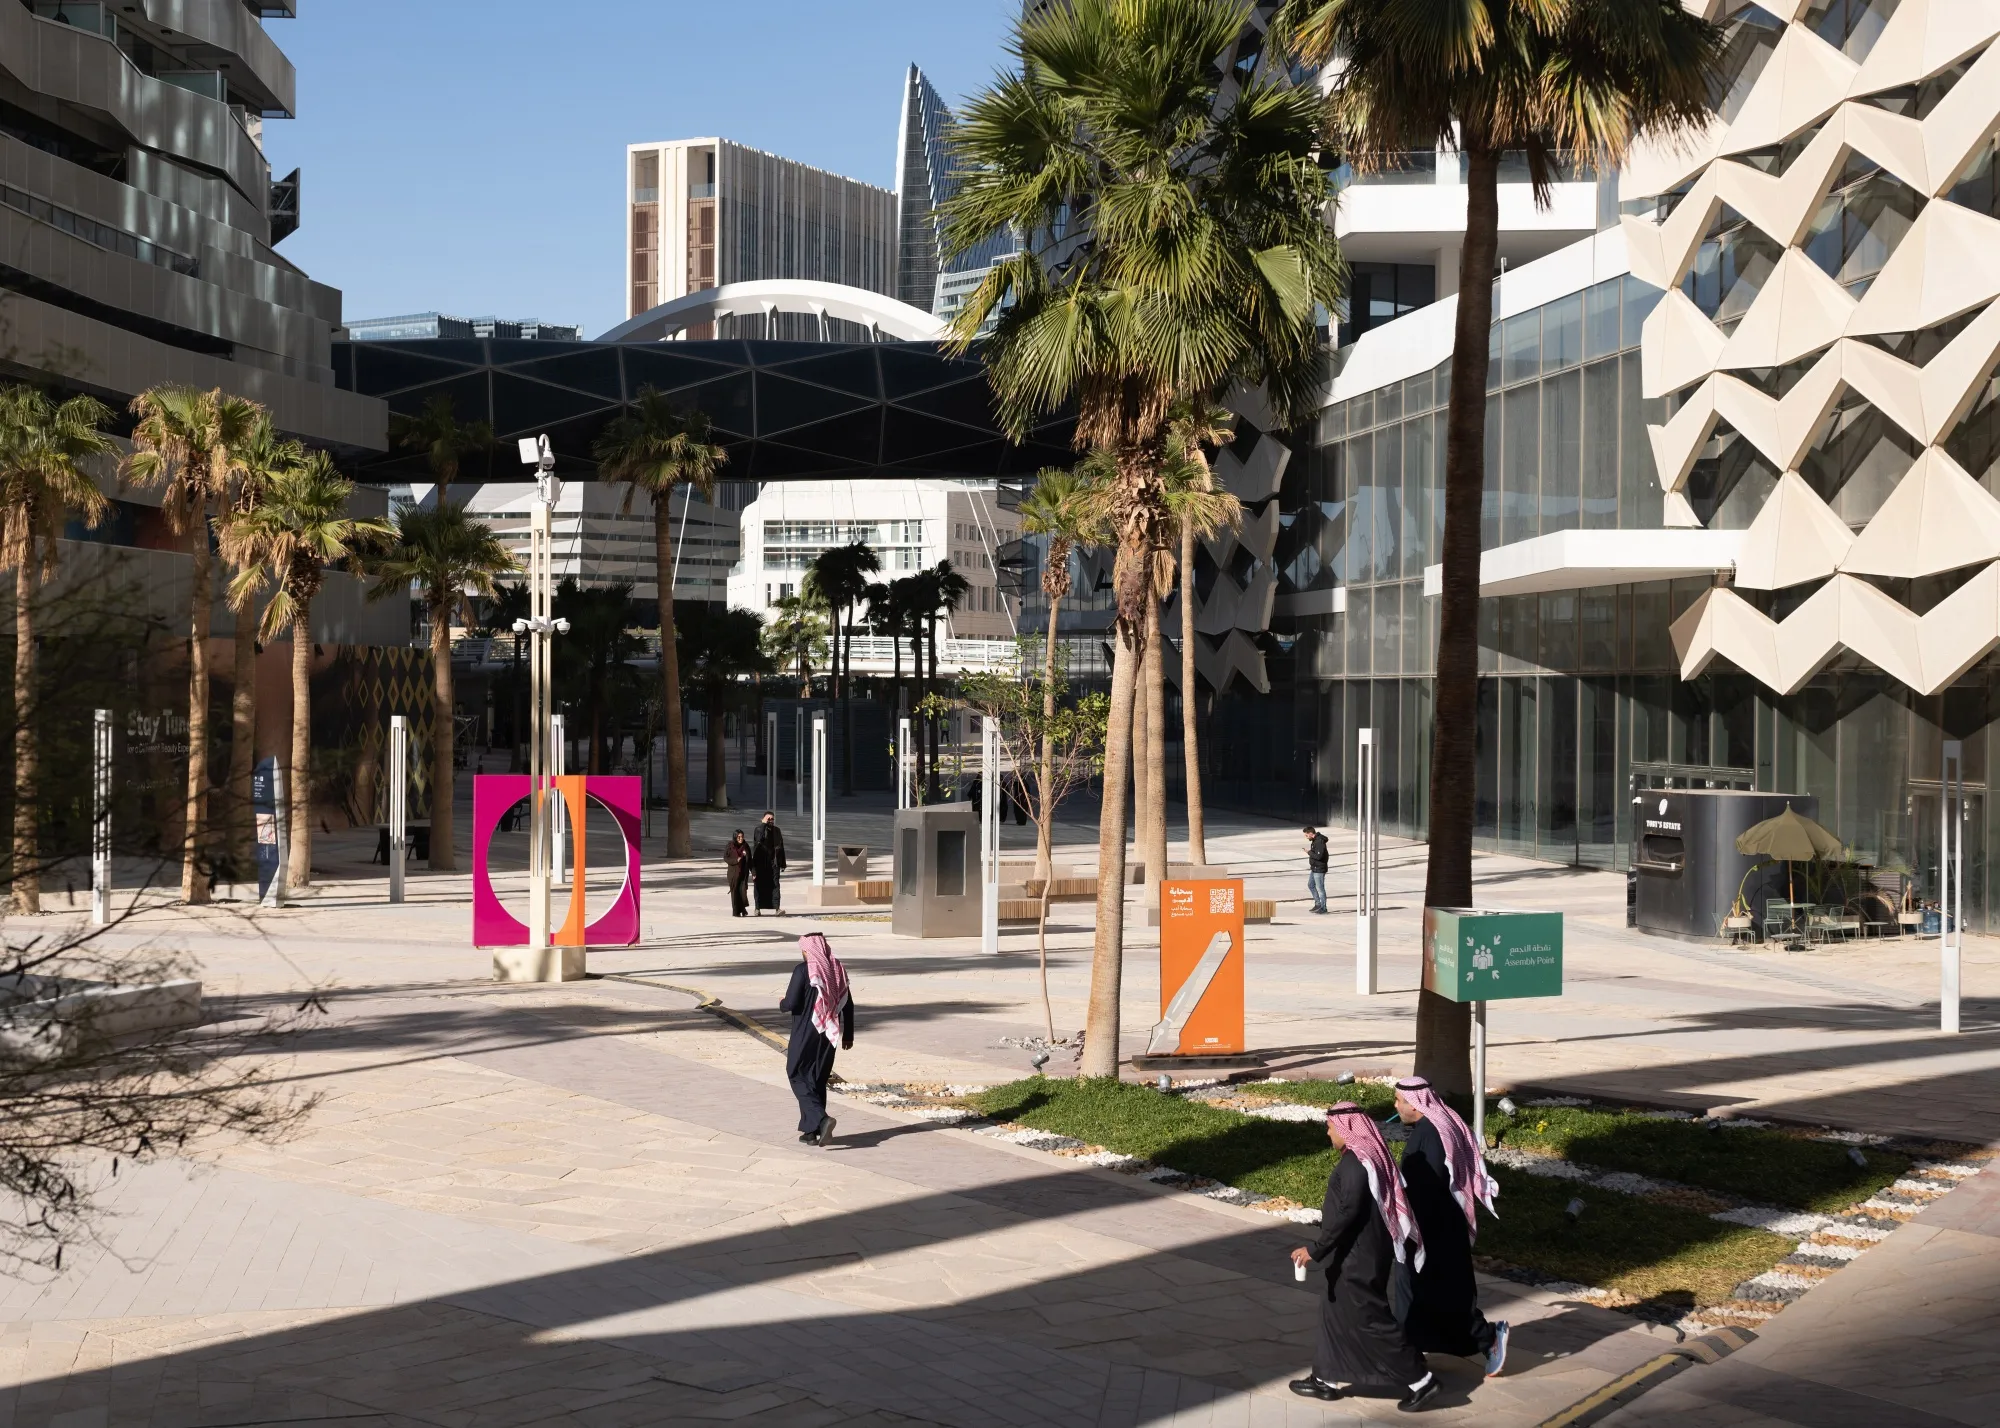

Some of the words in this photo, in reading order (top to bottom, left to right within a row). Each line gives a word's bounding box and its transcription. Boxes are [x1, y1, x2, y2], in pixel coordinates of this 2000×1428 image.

[127, 709, 161, 743] Stay
[161, 742, 177, 755] Beauty
[1646, 820, 1662, 829] TOBY'S
[1663, 821, 1681, 831] ESTATE
[1169, 887, 1193, 896] سحابة
[1509, 944, 1532, 956] التجمع
[1532, 944, 1552, 953] نقطة
[1505, 958, 1536, 967] Assembly
[1536, 956, 1555, 965] Point
